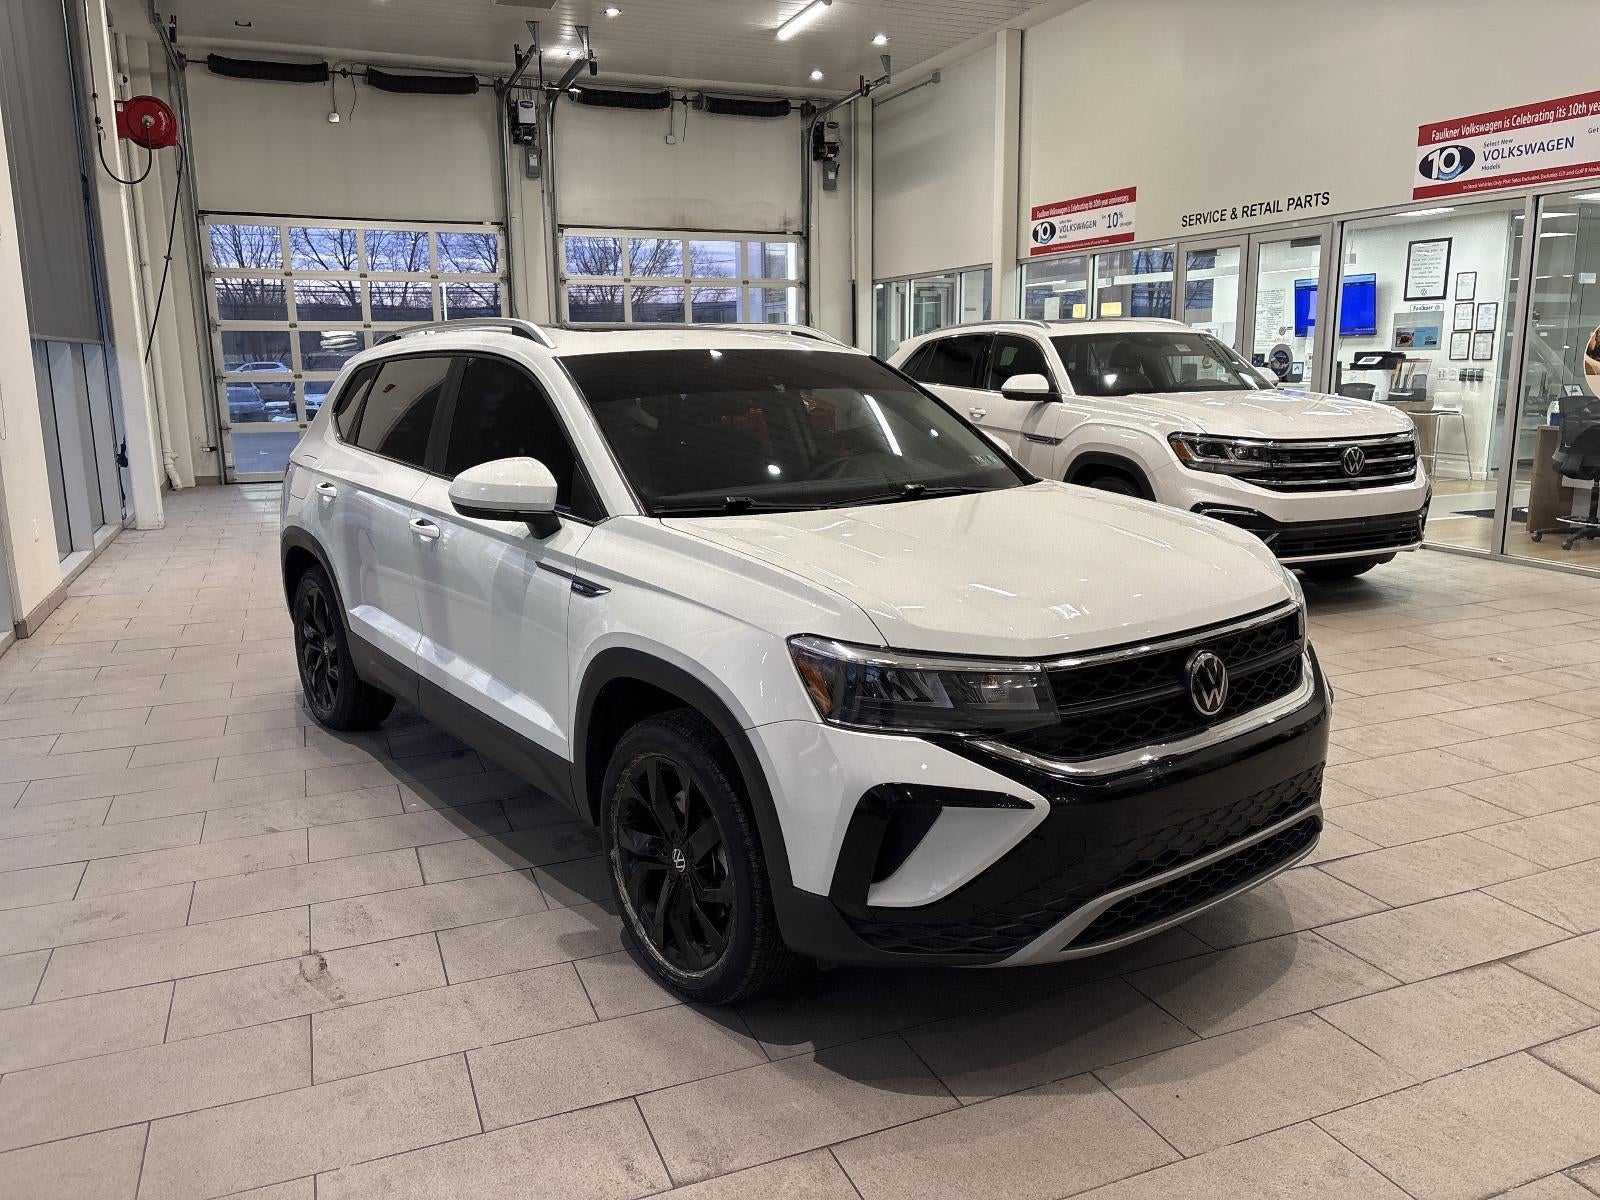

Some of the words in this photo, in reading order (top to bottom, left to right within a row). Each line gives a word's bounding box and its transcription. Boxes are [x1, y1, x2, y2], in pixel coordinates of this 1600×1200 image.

[1431, 128, 1460, 141] Faulkner
[1461, 120, 1503, 136] Volkswagen
[1504, 116, 1510, 128] is
[1511, 109, 1555, 126] Celebrating
[1567, 101, 1587, 117] 10th
[1587, 126, 1600, 134] Get
[1483, 140, 1500, 148] Select
[1483, 136, 1575, 162] VOLKSWAGEN
[1428, 147, 1460, 179] 10
[1481, 163, 1501, 171] Models
[1181, 208, 1227, 228] SERVICE
[1230, 207, 1238, 220] &
[1241, 200, 1283, 218] RETAIL
[1287, 191, 1330, 211] PARTS
[1059, 219, 1097, 234] VOLKSWAGEN
